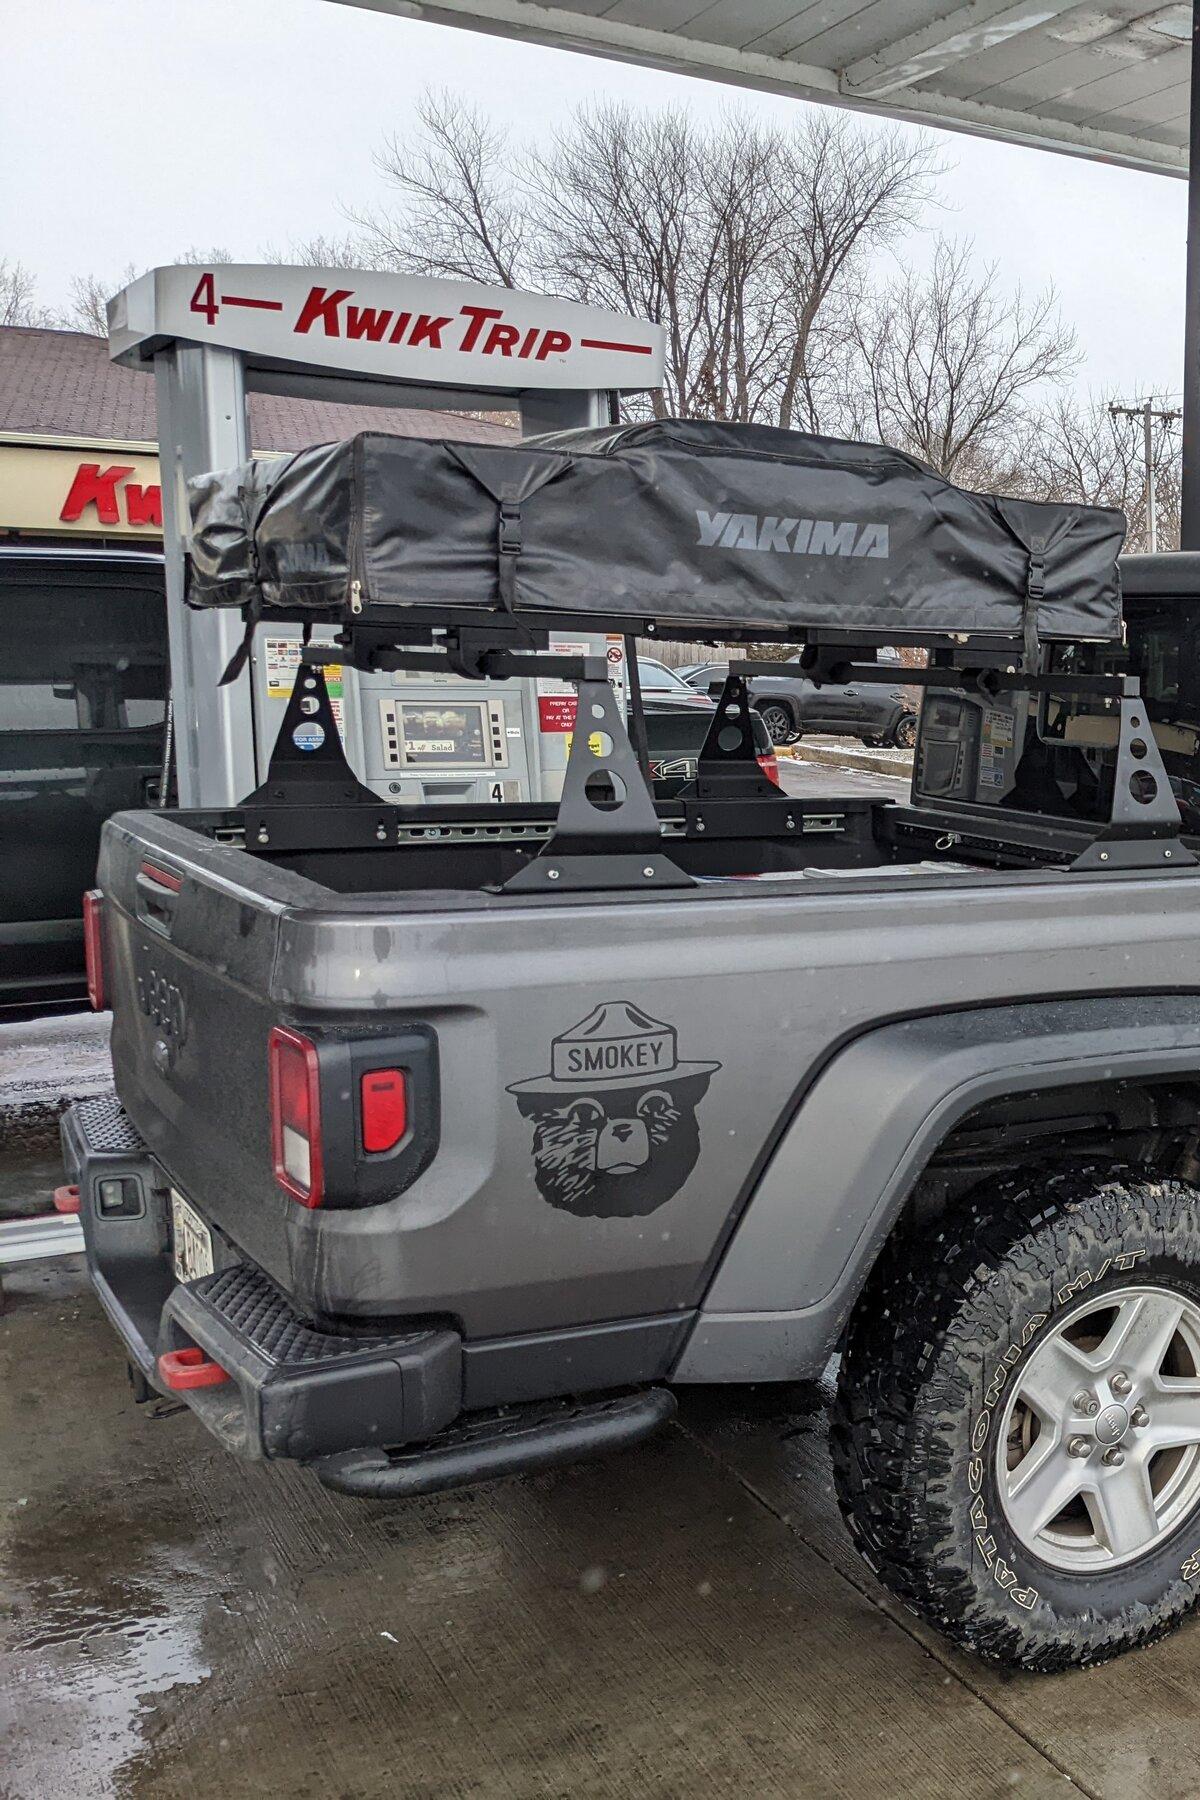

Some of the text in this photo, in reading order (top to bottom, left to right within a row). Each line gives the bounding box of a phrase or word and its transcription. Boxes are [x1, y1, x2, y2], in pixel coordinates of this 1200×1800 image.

[190, 273, 219, 325] 4
[293, 286, 454, 350] KWIK
[458, 305, 572, 361] TRIP
[696, 510, 889, 559] YAKIMA
[491, 783, 503, 802] 4
[567, 1041, 663, 1073] SMOKEY
[968, 1249, 1146, 1609] PATAGONIA M/T
